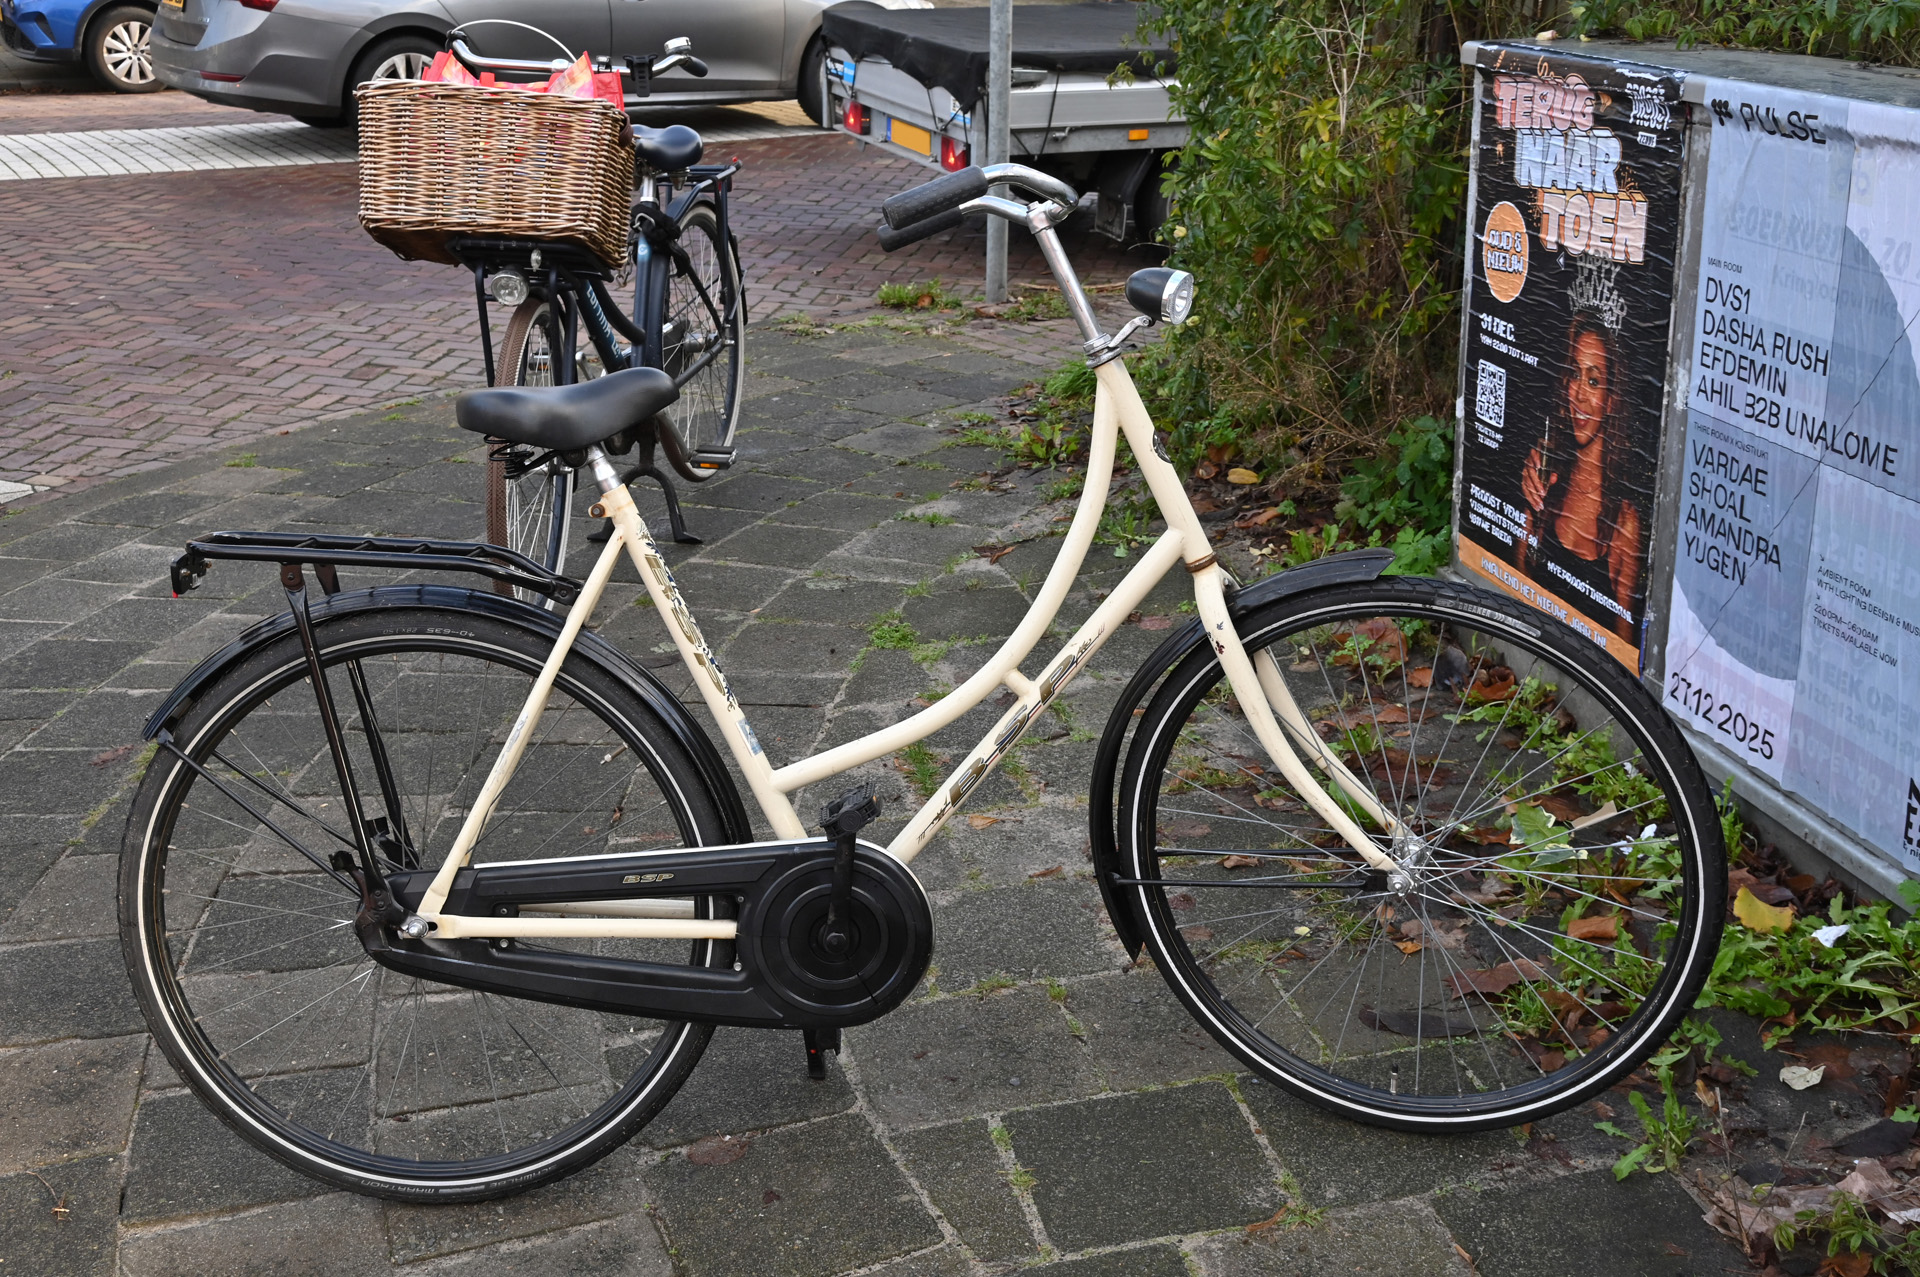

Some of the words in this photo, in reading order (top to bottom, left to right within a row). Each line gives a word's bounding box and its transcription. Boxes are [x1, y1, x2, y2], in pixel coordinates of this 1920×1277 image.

[1494, 75, 1594, 131] TERUG
[1740, 102, 1826, 144] PULSE
[1515, 128, 1621, 193] NAAR
[1488, 229, 1512, 250] OUD
[1514, 231, 1522, 253] &
[1539, 188, 1648, 264] TOEN
[1487, 249, 1524, 274] NIEUW
[1708, 256, 1722, 269] MAIN
[1723, 260, 1742, 274] ROOM
[1705, 277, 1750, 314] DVS1
[1479, 312, 1493, 331] 31
[1493, 317, 1516, 342] DEC.
[1703, 309, 1767, 356] DASHA
[1772, 332, 1829, 376] RUSH
[1700, 341, 1787, 397] EFDEMIN
[1696, 374, 1740, 413] AHIL
[1744, 392, 1780, 428] B2B
[1785, 407, 1898, 476] UNALOME
[1692, 439, 1768, 497] VARDAE
[1470, 483, 1502, 511] PROOST
[1689, 471, 1751, 523] SHOAL
[1491, 524, 1513, 546] BREDA
[1685, 503, 1781, 572] AMANDRA
[1684, 531, 1746, 586] YUGEN
[1817, 565, 1848, 586] AMBIENT
[1458, 602, 1490, 617] BREAKER
[1481, 556, 1520, 591] KNALLEND
[1520, 582, 1536, 602] HET
[1537, 594, 1568, 624] NIEUWE
[426, 627, 475, 637] 40-635
[1813, 615, 1840, 638] TICKETS
[1840, 631, 1878, 658] AVAILABLE
[1868, 602, 1895, 624] DESIGN
[1902, 620, 1920, 638] MUS
[949, 653, 1077, 808] BSP
[622, 872, 675, 884] BSP
[360, 1178, 435, 1194] MARATHON
